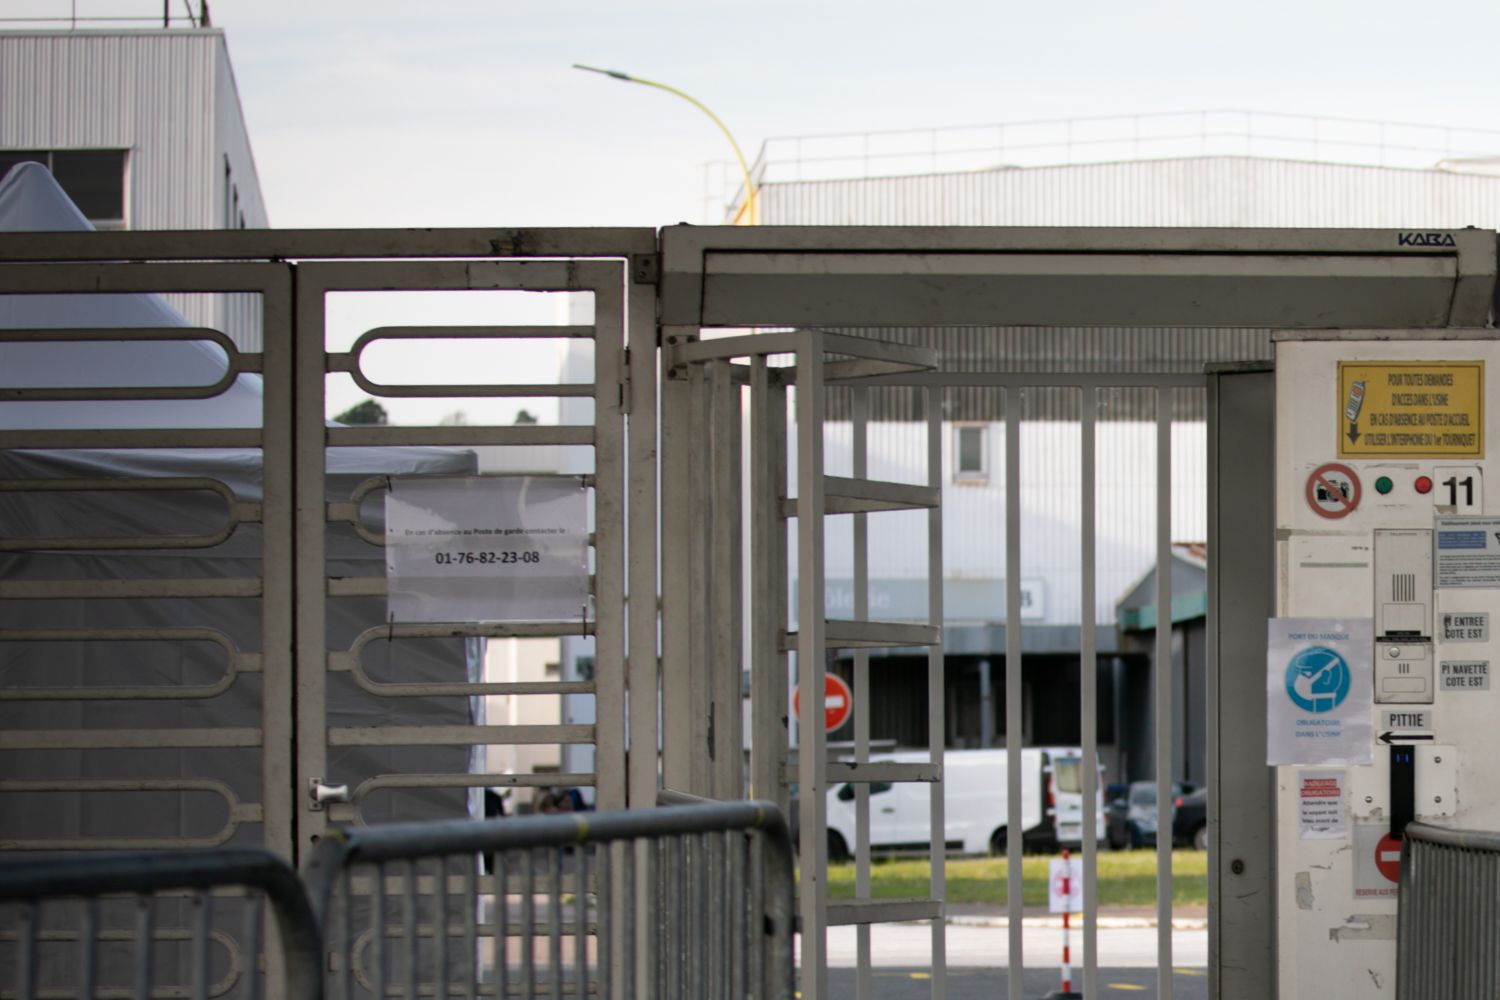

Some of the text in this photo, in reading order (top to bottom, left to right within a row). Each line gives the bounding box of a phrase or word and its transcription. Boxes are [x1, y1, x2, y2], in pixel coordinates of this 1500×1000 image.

[1398, 232, 1456, 247] KABA
[1387, 373, 1403, 386] POUR
[1442, 476, 1473, 506] 11
[504, 528, 524, 537] garde
[435, 551, 540, 565] 01-76-82-23-08
[1454, 616, 1485, 627] ENTREE
[1467, 628, 1483, 639] EST
[1452, 664, 1487, 675] NAVETTE
[1446, 676, 1483, 687] COTE EST
